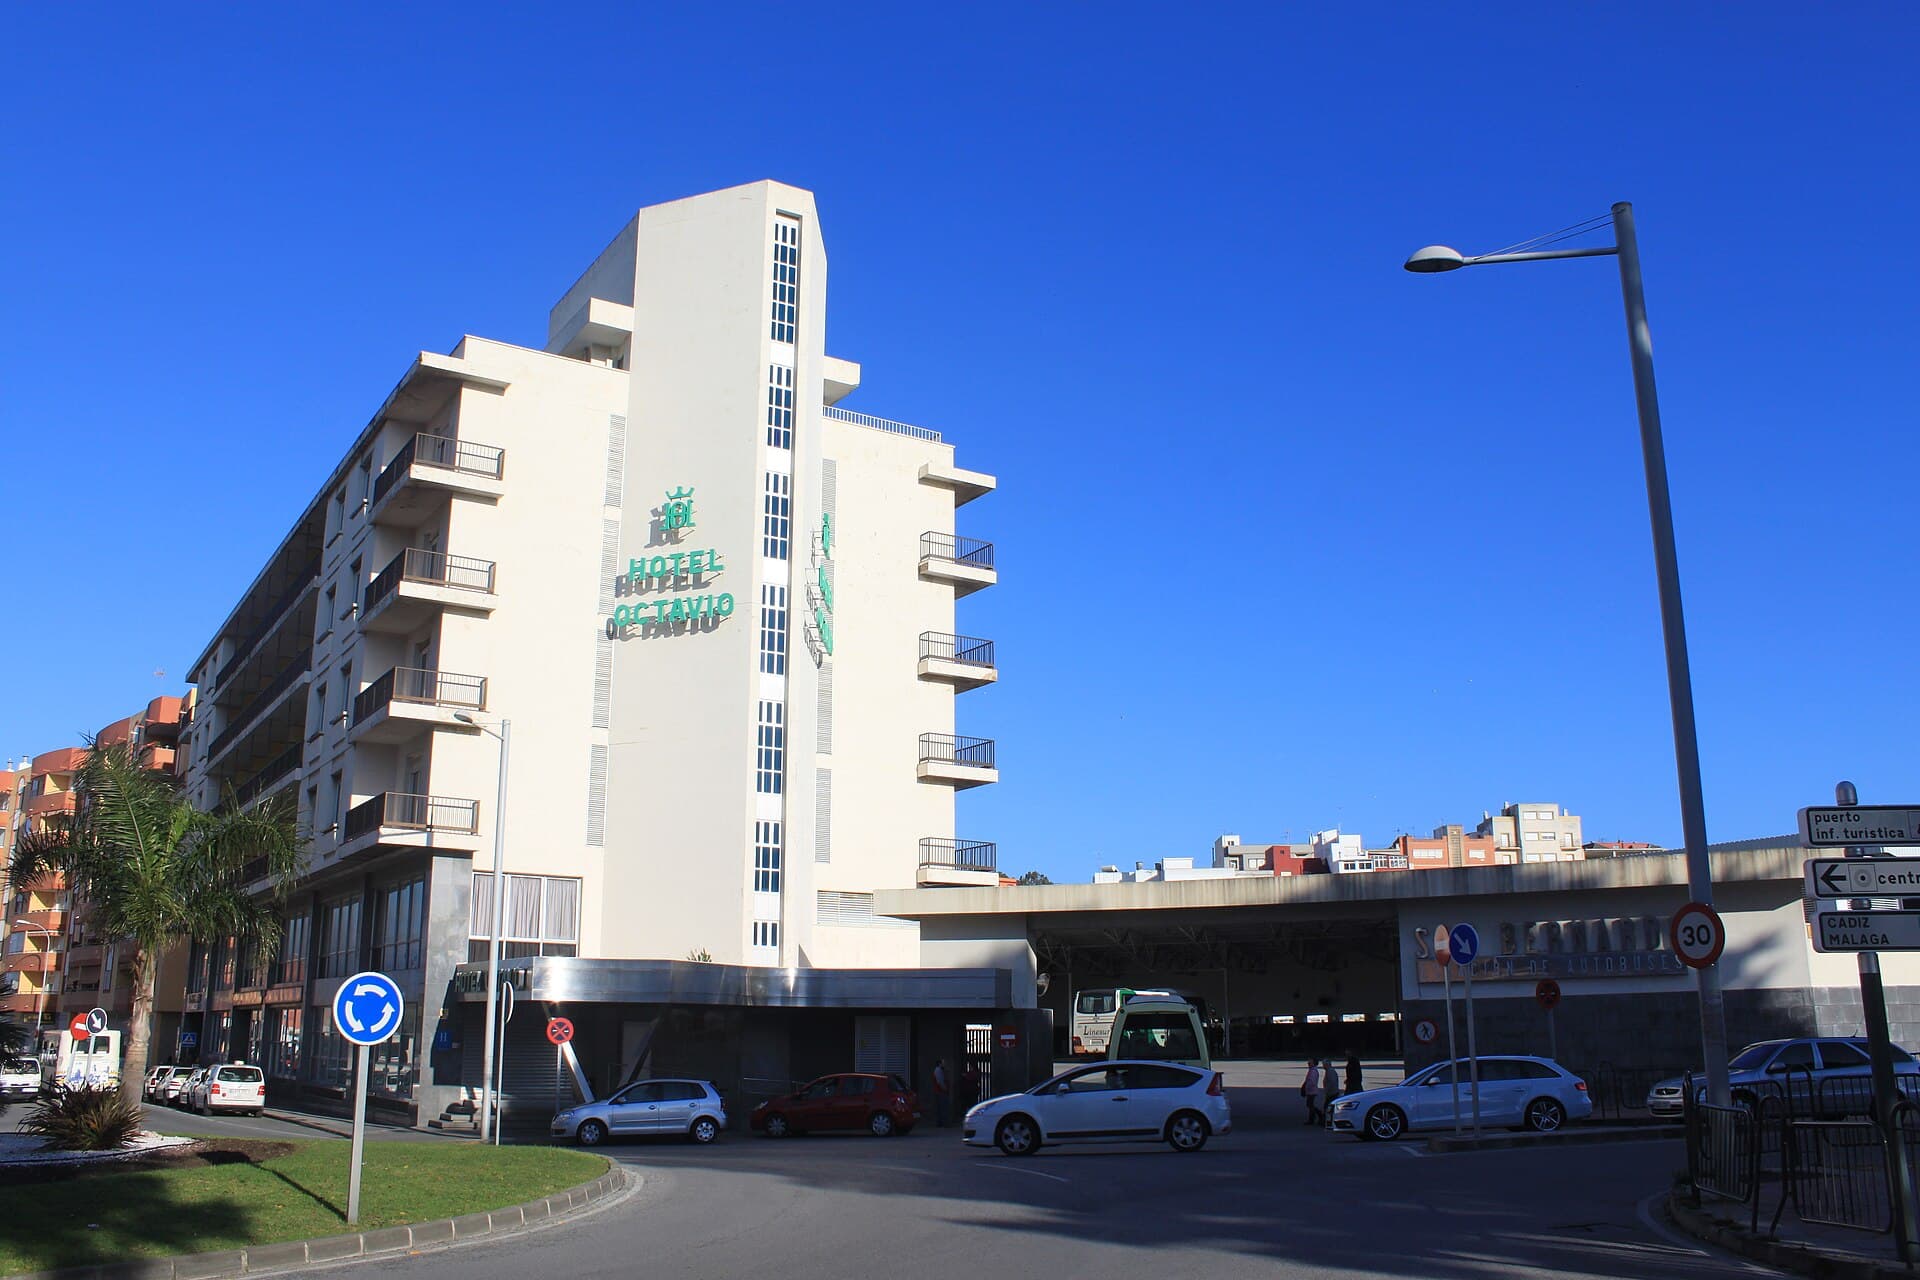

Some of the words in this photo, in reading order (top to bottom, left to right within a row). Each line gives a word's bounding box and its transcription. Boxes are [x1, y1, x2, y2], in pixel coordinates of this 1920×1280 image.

[629, 549, 724, 582] HOTEL
[614, 593, 735, 627] OCTAVIO
[1815, 812, 1861, 825] puerto
[1817, 829, 1840, 839] inf.
[1827, 917, 1870, 929] CADIZ
[1500, 917, 1665, 954] BERNARD
[1682, 924, 1711, 946] 30
[1829, 934, 1890, 946] MALAGA
[1529, 959, 1548, 976] DE
[1567, 954, 1683, 975] AUTOBUSES
